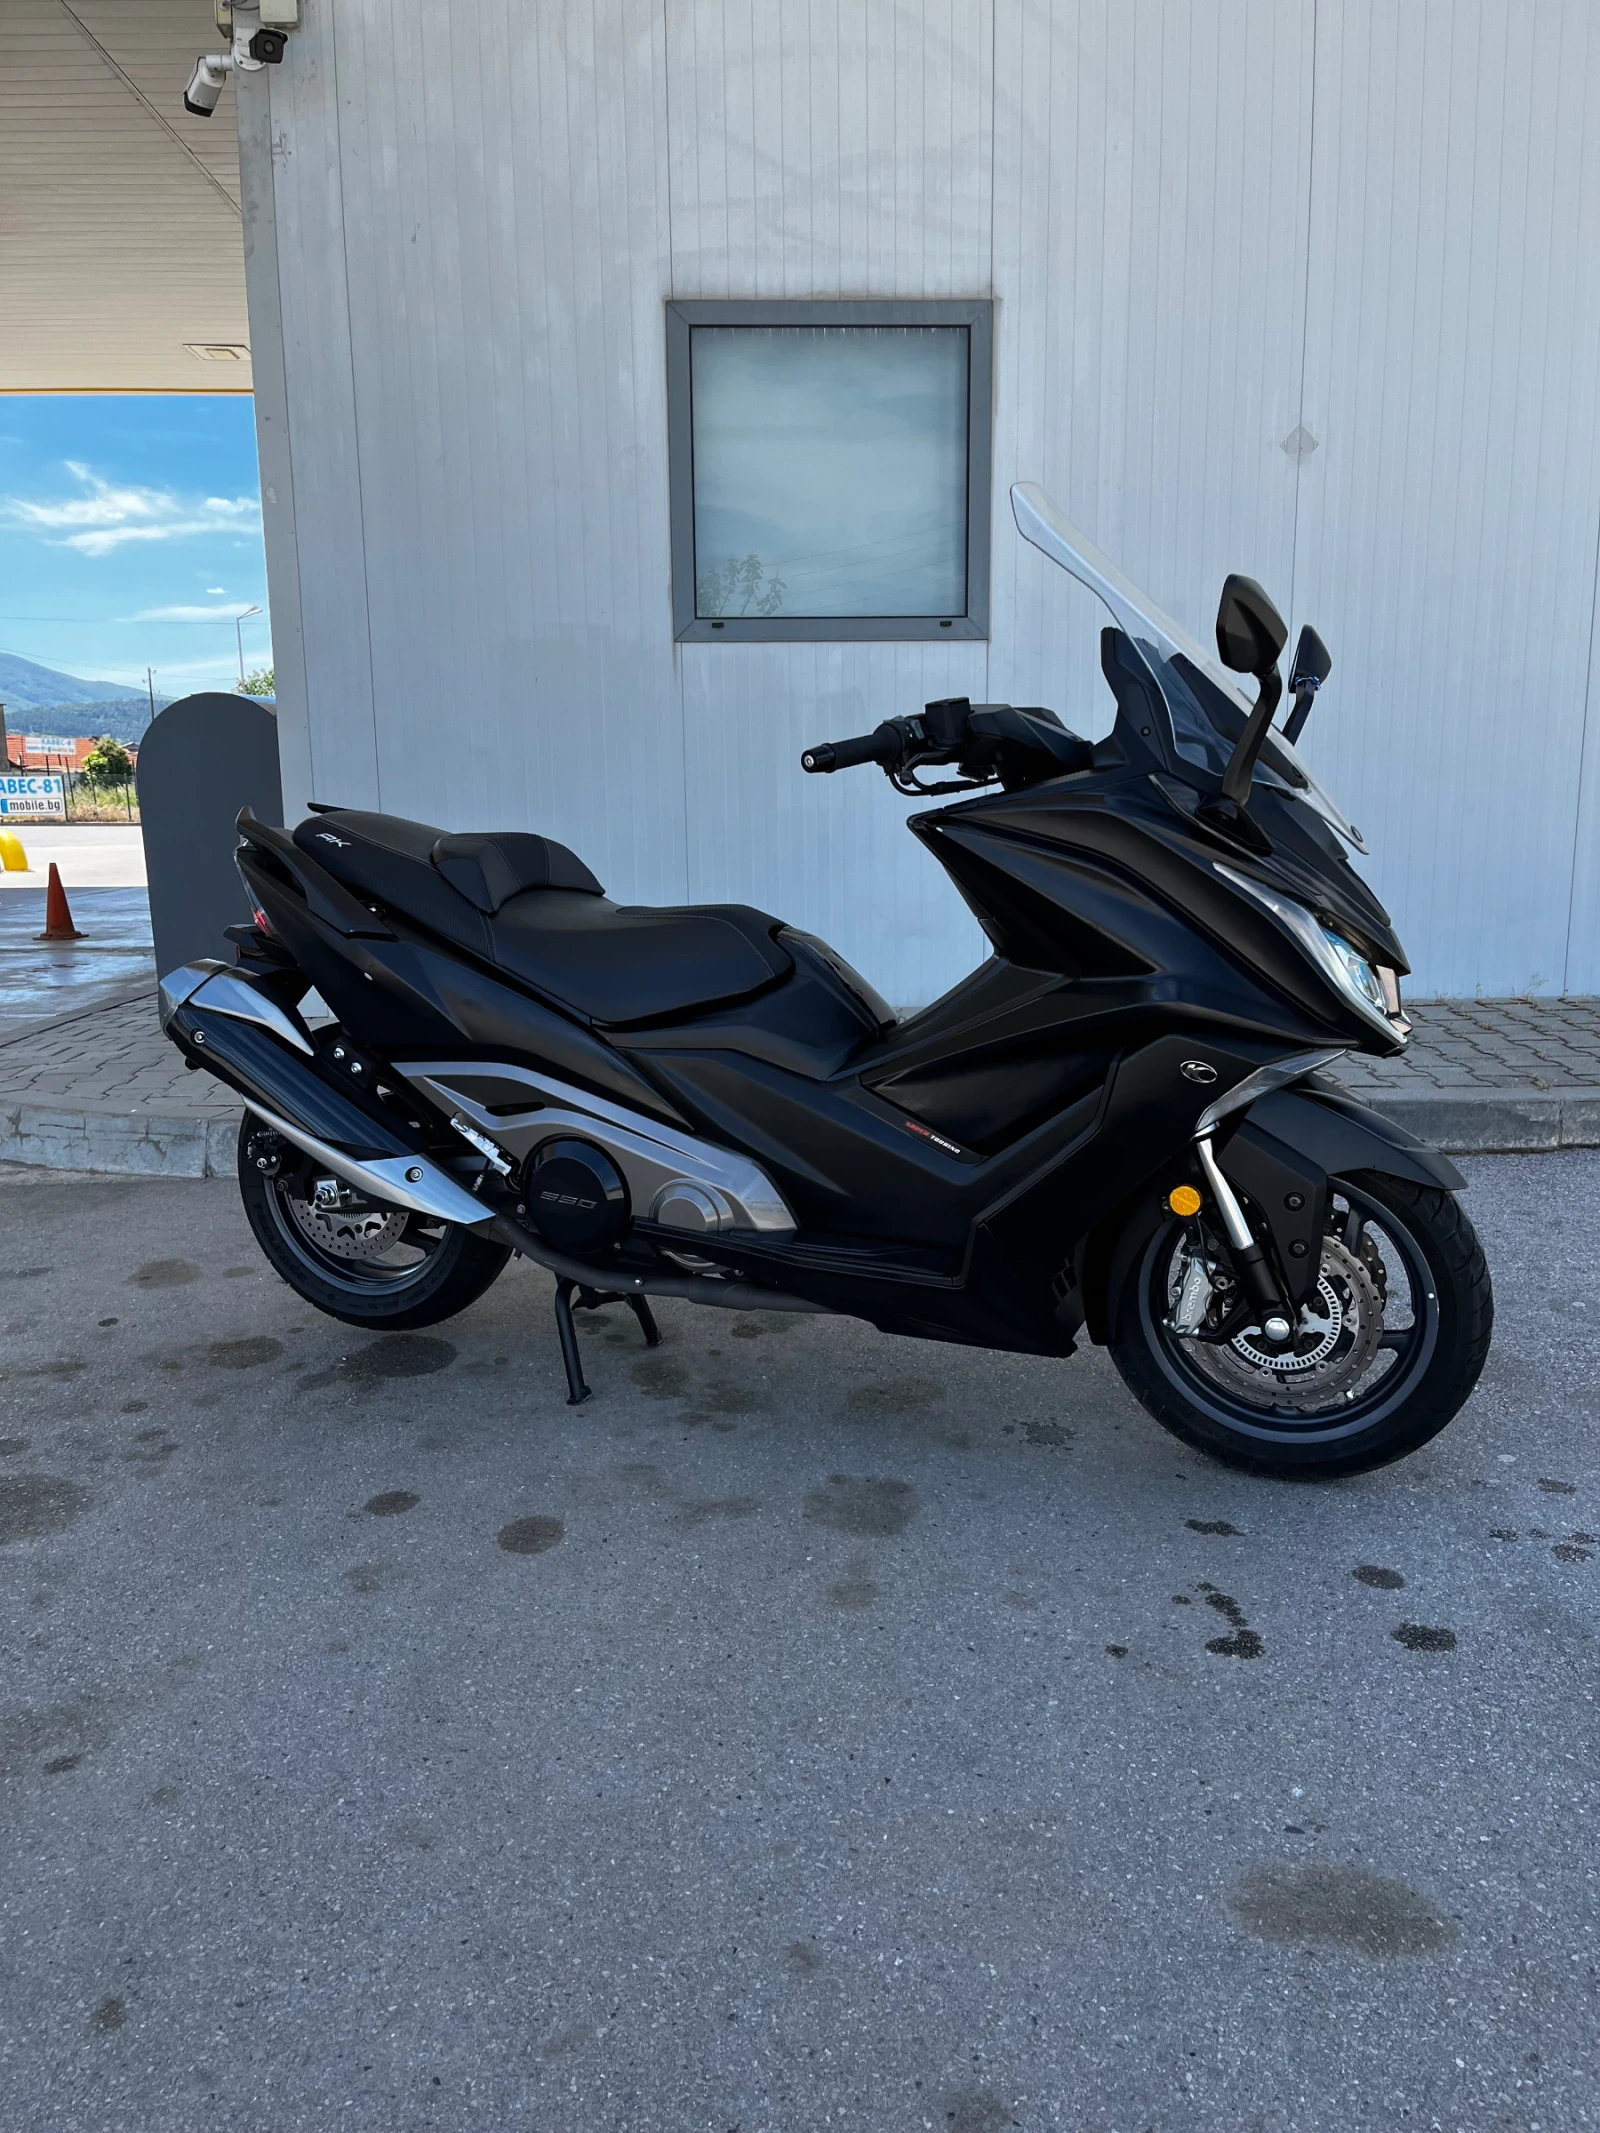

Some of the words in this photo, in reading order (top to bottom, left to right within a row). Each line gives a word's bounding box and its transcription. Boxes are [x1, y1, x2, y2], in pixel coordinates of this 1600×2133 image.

[9, 799, 61, 811] mobile.bg
[930, 1134, 961, 1154] TOURING
[1181, 1277, 1201, 1321] brembo
